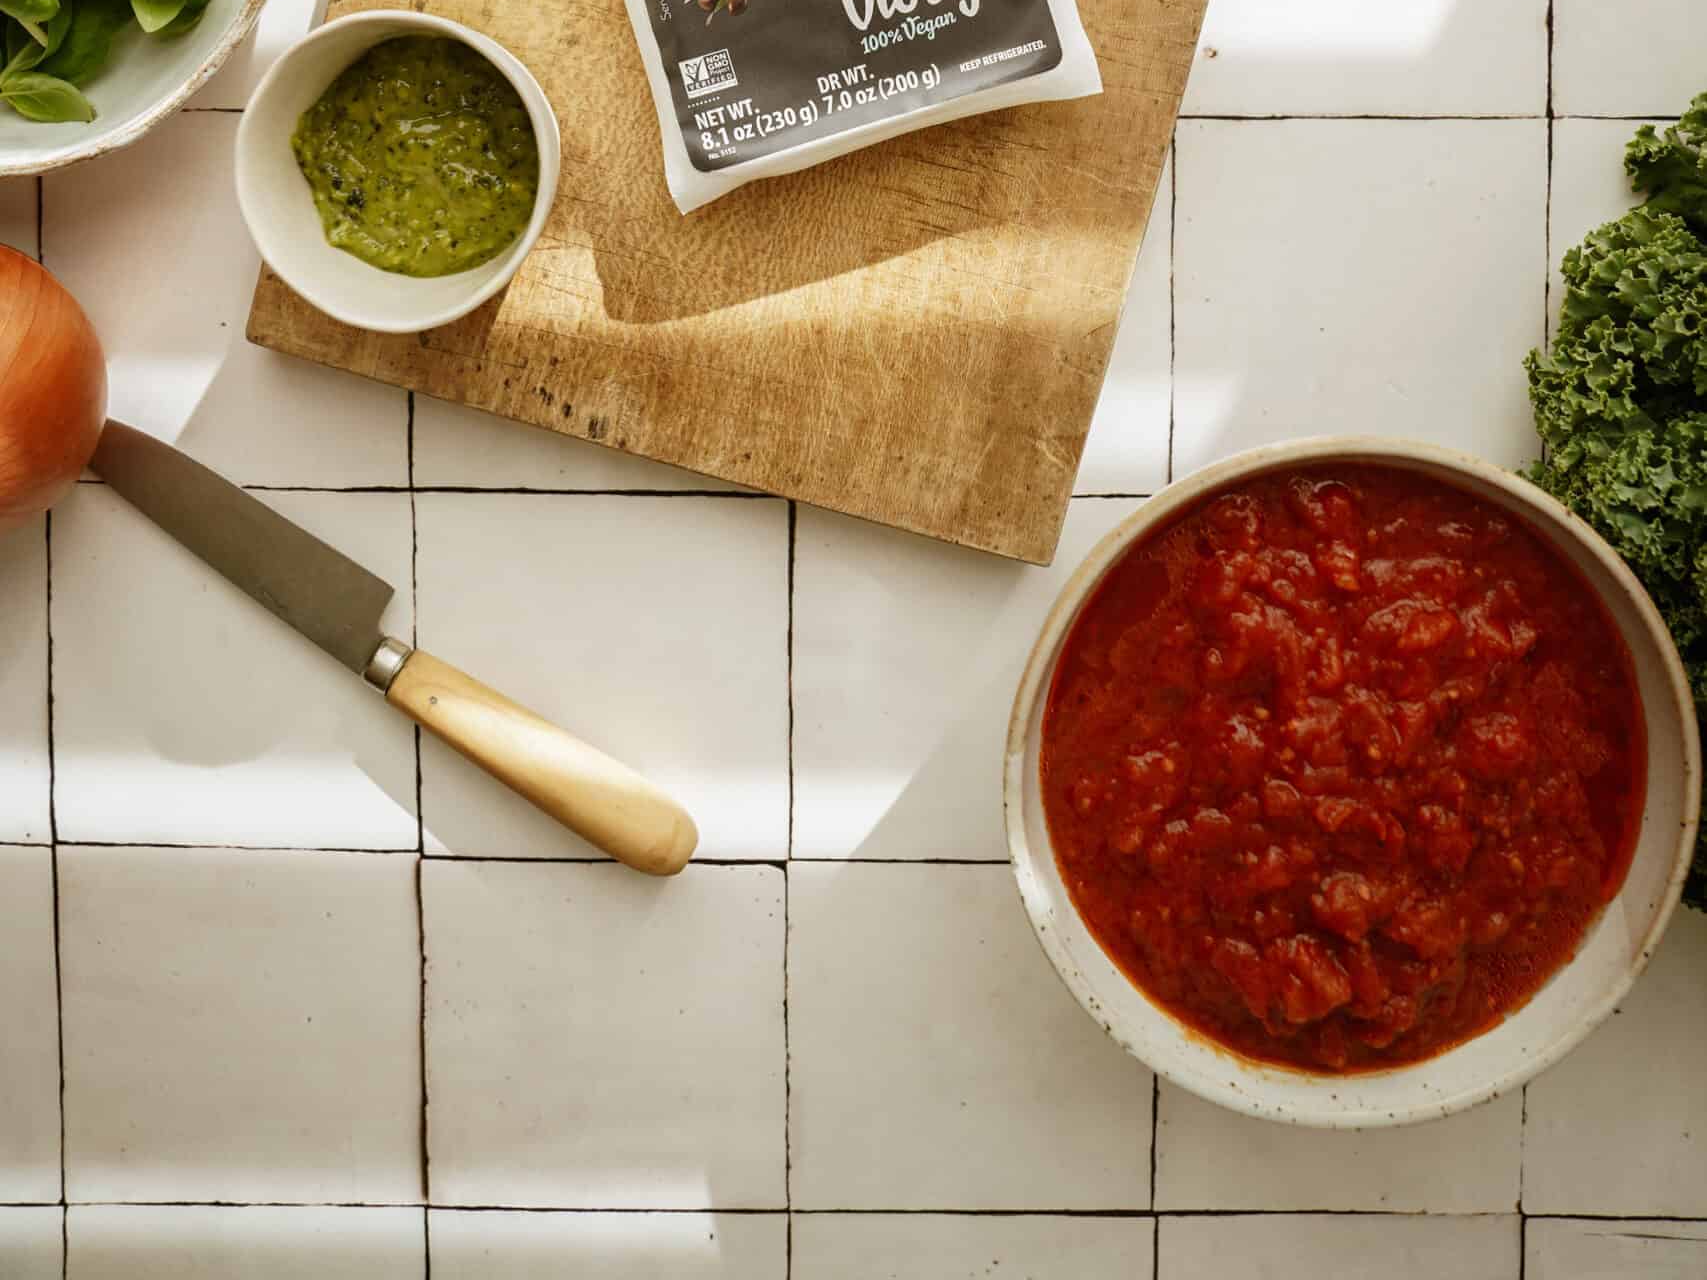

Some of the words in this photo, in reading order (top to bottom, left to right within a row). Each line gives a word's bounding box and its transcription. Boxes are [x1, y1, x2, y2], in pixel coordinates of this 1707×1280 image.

[860, 29, 903, 54] 100%
[901, 12, 957, 40] Vegan
[706, 52, 727, 64] NON
[707, 59, 729, 72] GMO
[959, 58, 982, 72] KEEP
[983, 40, 1047, 66] REFRIGERATED.
[817, 73, 842, 94] DR
[841, 64, 875, 86] WT.
[822, 90, 852, 114] 7.0
[855, 86, 877, 105] oz
[878, 71, 919, 99] (200
[922, 63, 940, 90] g)
[694, 107, 725, 130] NET
[726, 98, 760, 121] WT.
[701, 127, 730, 150] 8.1
[733, 124, 755, 140] oz
[756, 107, 797, 136] (230
[799, 100, 818, 126] g)
